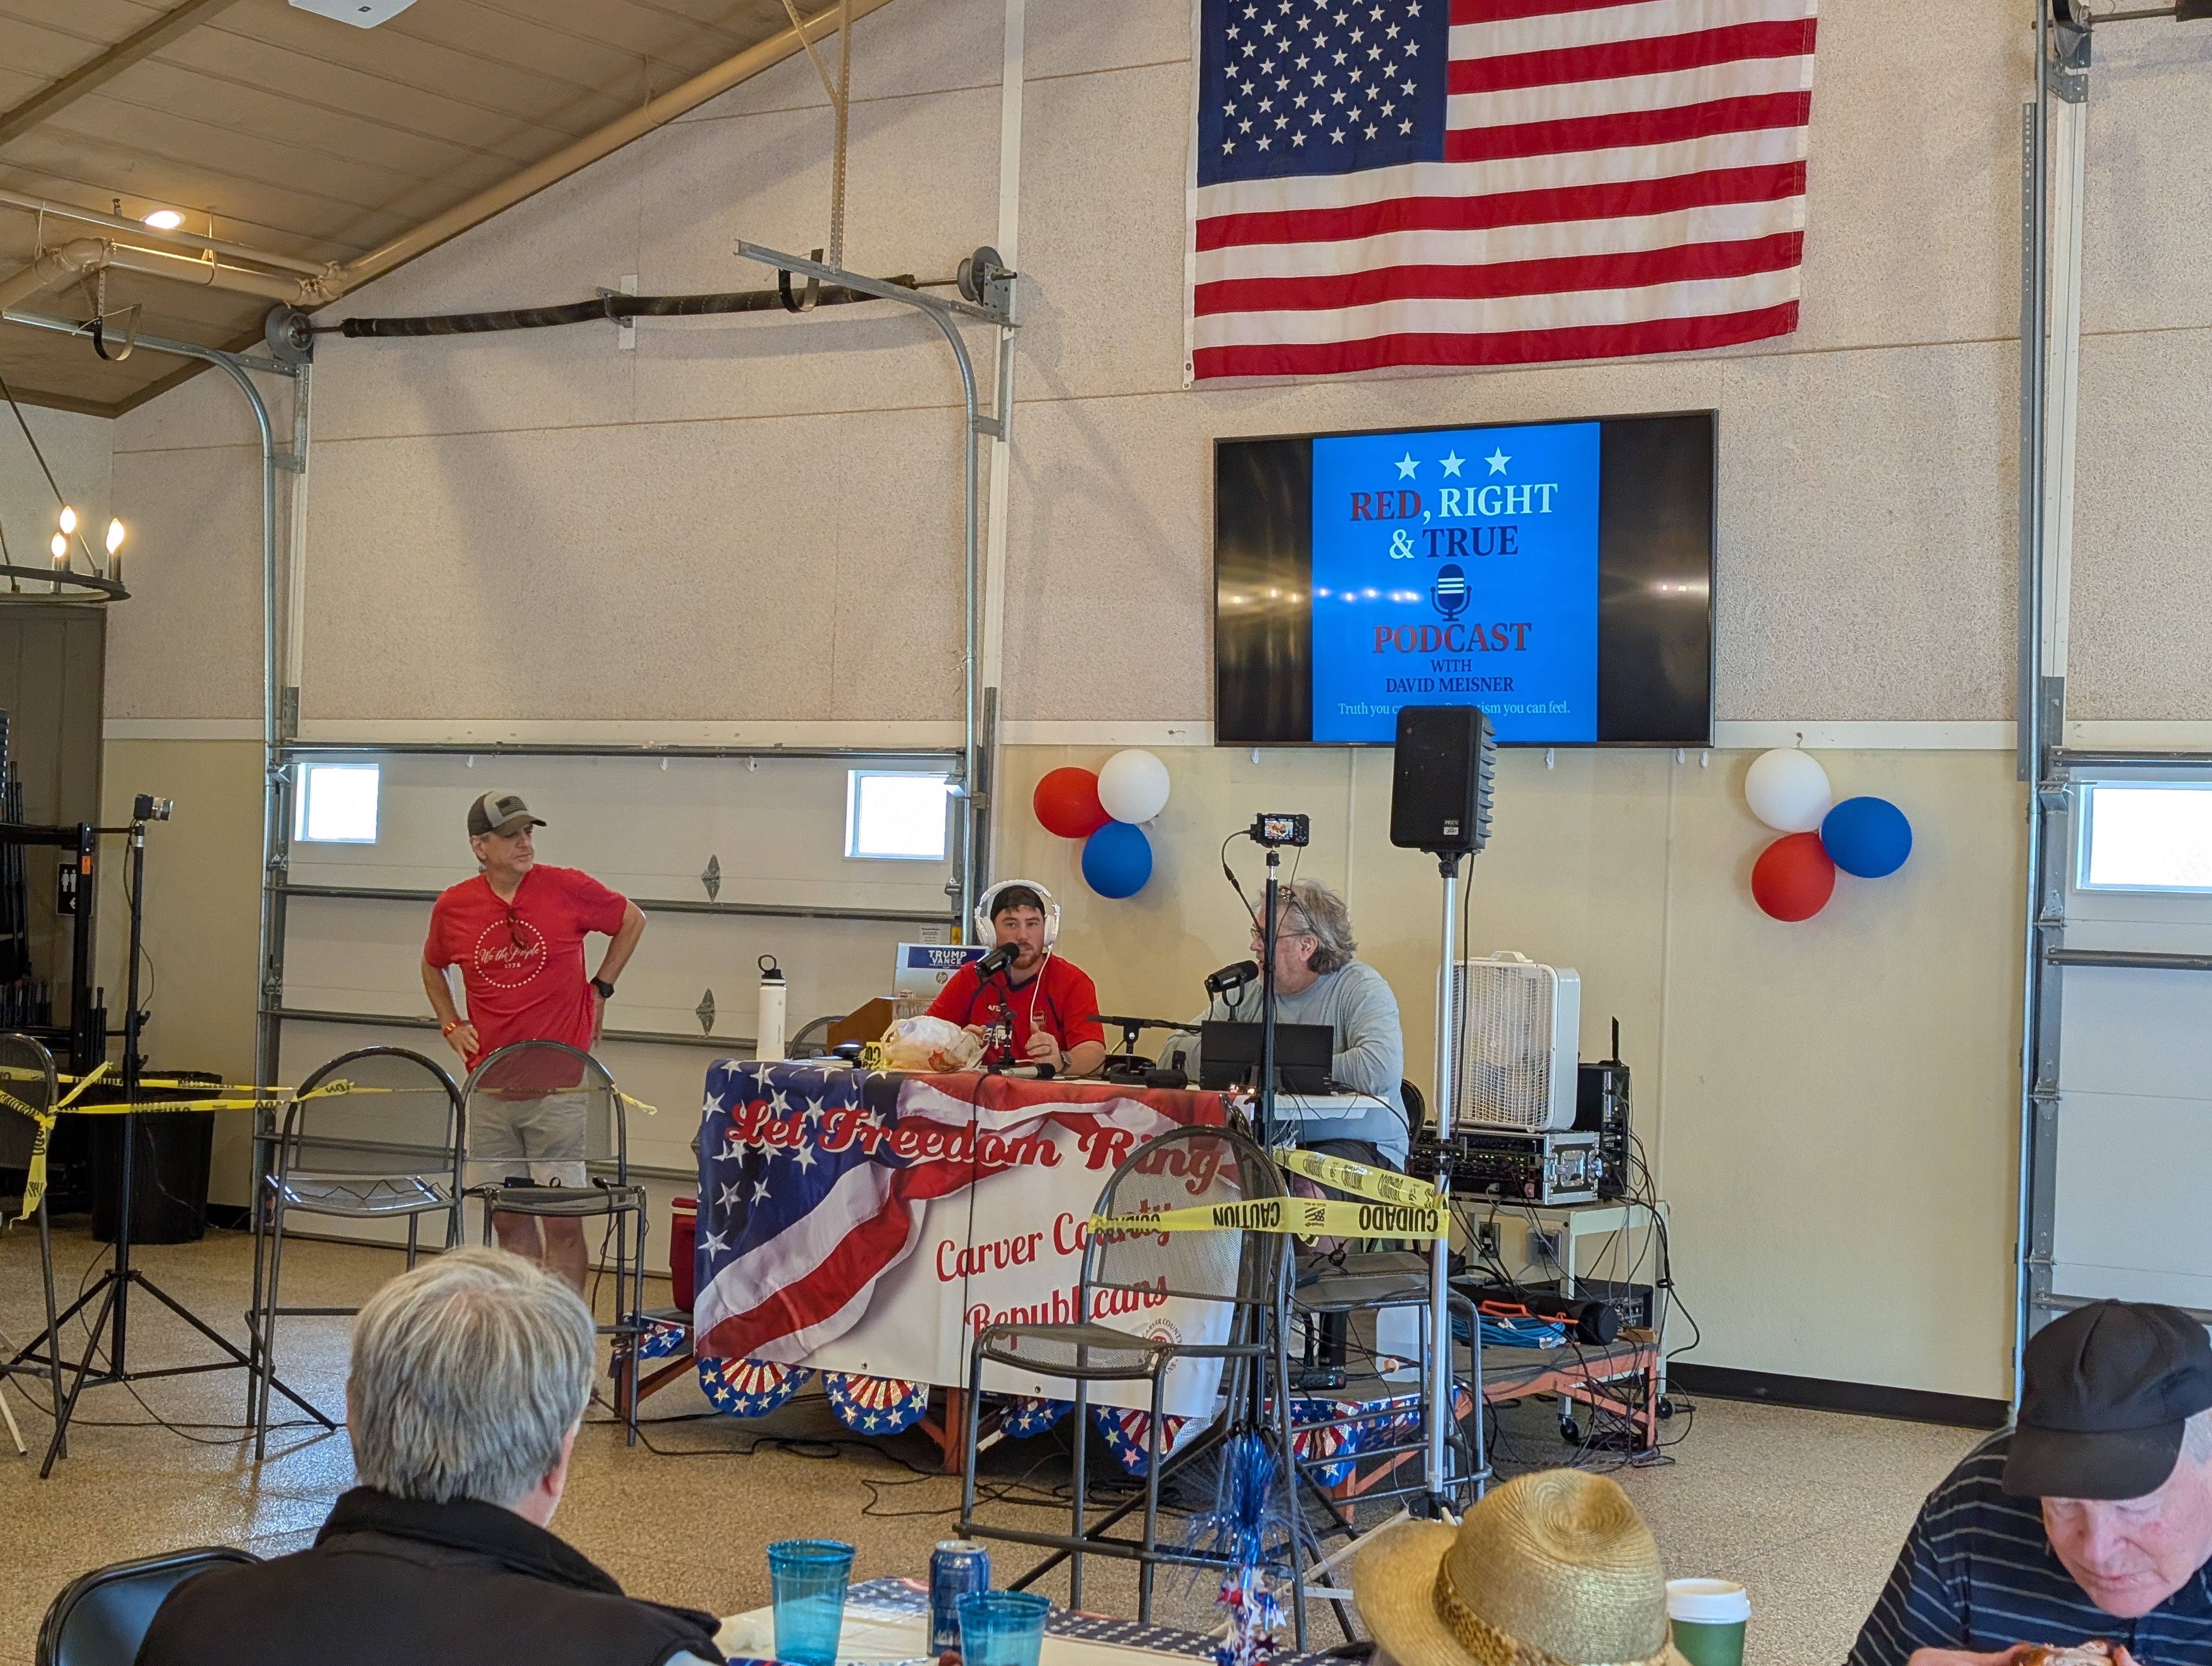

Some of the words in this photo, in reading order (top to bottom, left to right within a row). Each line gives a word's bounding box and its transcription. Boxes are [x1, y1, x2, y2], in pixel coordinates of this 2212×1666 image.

[1349, 490, 1430, 524] RED,
[1438, 483, 1558, 517] RIGHT
[1389, 529, 1414, 559] &
[1422, 526, 1519, 558] TRUE
[1373, 623, 1532, 654] PODCAST
[1430, 659, 1472, 672] WITH
[1386, 678, 1435, 693] DAVID
[1439, 677, 1514, 692] MEISNER
[1338, 702, 1368, 714] Truth
[1371, 706, 1390, 720] you
[1503, 704, 1524, 716] you
[1526, 704, 1546, 714] can
[1548, 701, 1571, 714] feel.
[479, 947, 495, 964] We
[494, 947, 509, 961] the
[504, 943, 539, 963] People
[928, 950, 967, 958] TRUMP
[937, 972, 947, 984] hp
[725, 1099, 807, 1149] Let
[819, 1107, 1065, 1170] Freedom
[1077, 1126, 1224, 1196] Ring
[1213, 1201, 1281, 1229] CAUTION
[1359, 1206, 1438, 1232] CUIDADO
[936, 1232, 1044, 1282] Carver
[1053, 1200, 1172, 1255] Coy
[964, 1275, 1169, 1351] Republcans
[1162, 1318, 1183, 1344] COUNTY
